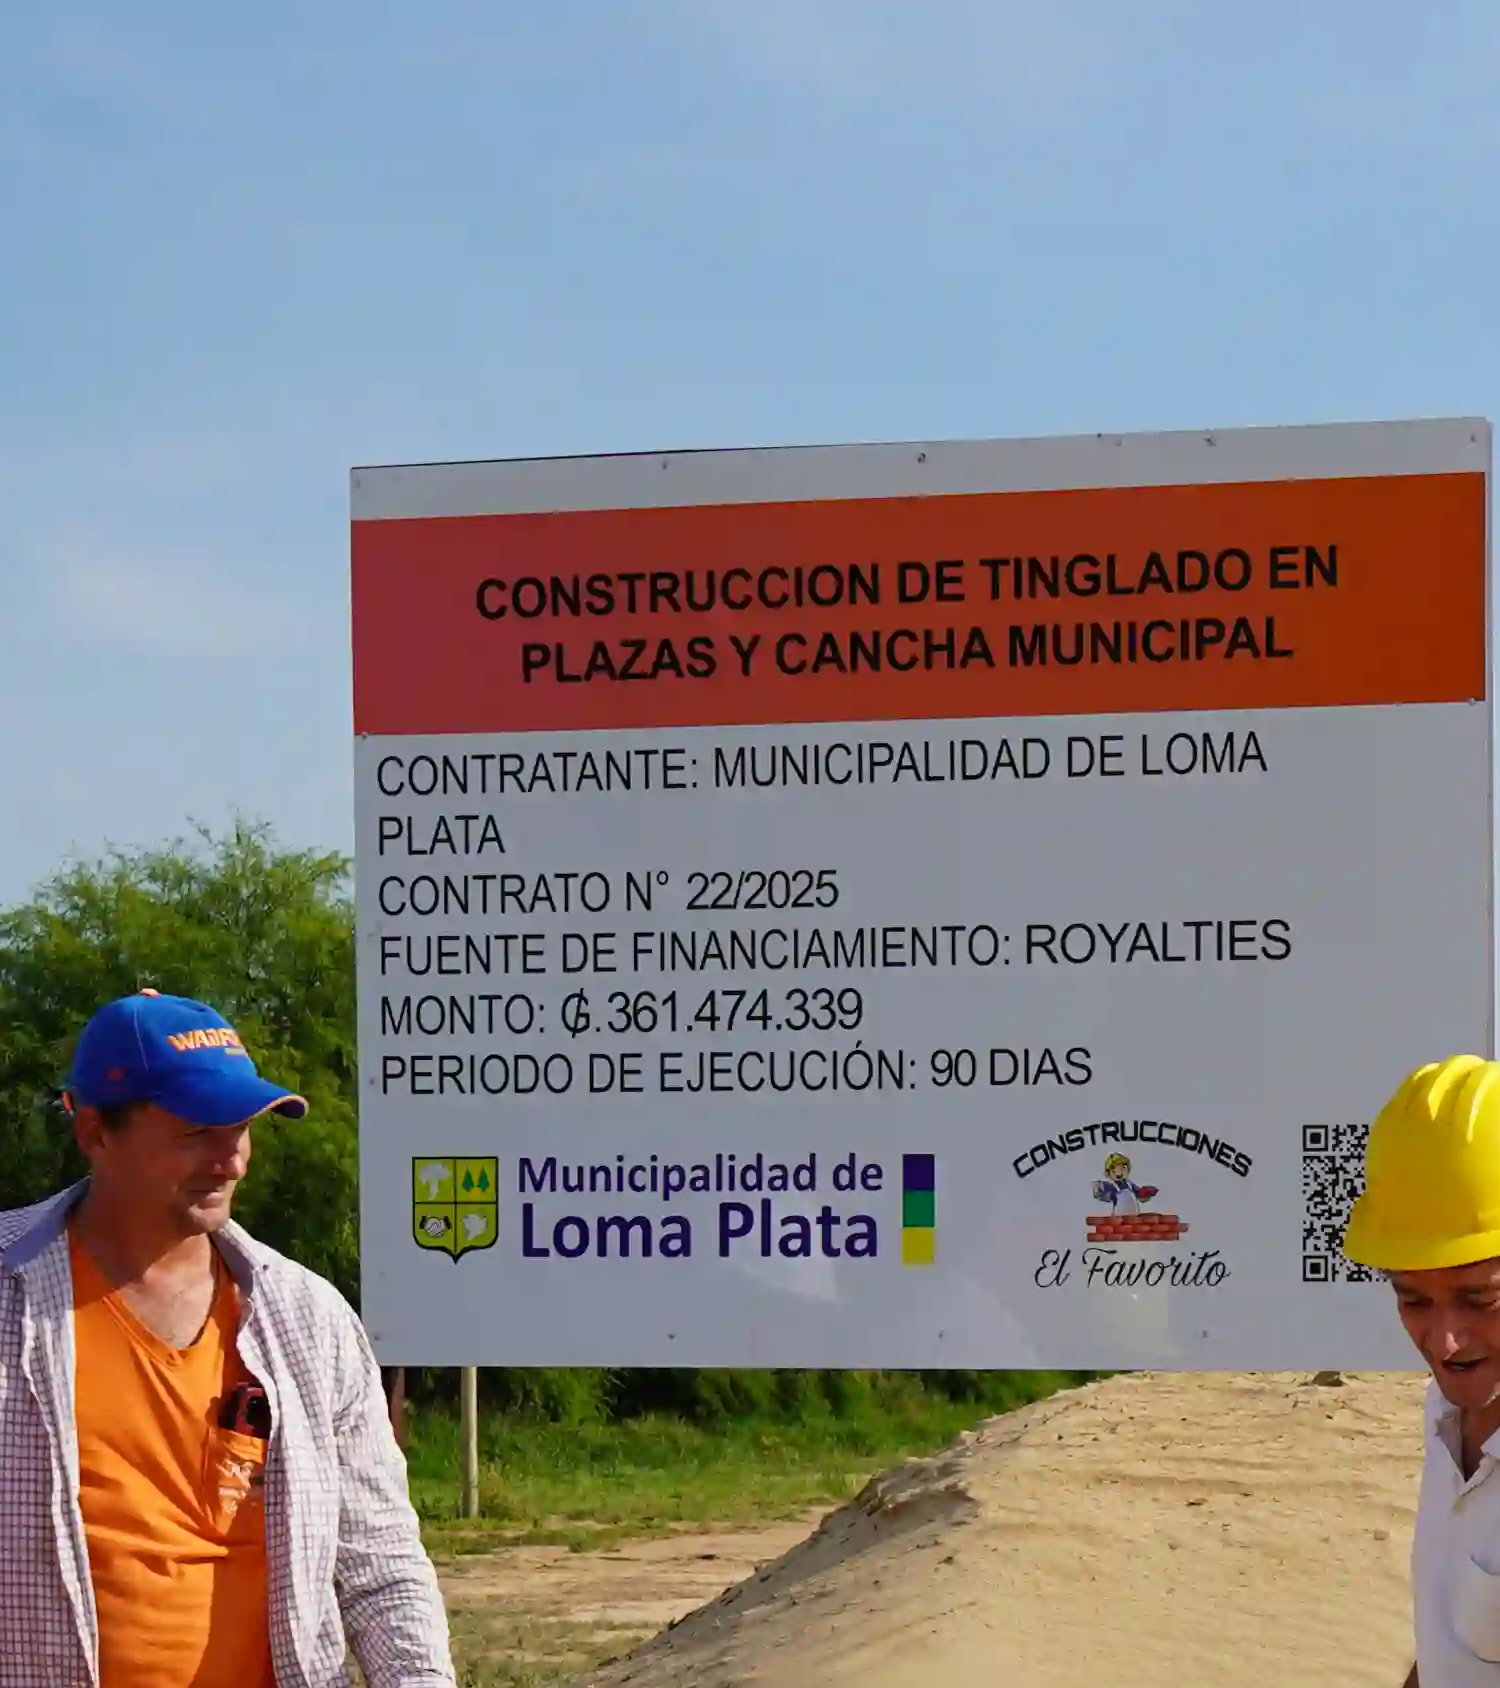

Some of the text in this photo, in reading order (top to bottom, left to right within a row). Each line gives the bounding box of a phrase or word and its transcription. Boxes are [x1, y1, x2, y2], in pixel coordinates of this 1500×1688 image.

[476, 544, 1338, 621] CONSTRUCCION DE TINGLADO EN
[522, 616, 1294, 684] PLAZAS Y CANCHA MUNICIPAL
[377, 730, 1268, 796] CONTRATANTE: MUNICIPALIDAD DE LOMA
[378, 814, 506, 856] PLATA
[378, 871, 610, 916] CONTRATO
[686, 869, 839, 910] 22/2025
[380, 919, 1292, 976] FUENTE DE FINANCIAMIENTO: ROYALTIES
[381, 994, 545, 1036] MONTO:
[382, 1039, 1092, 1095] PERIODO DE EJECUCIÓN: 90 DIAS
[518, 1152, 883, 1201] Municipalidad de
[1012, 1120, 1253, 1178] CONSTRUCCIONES
[522, 1197, 878, 1259] Loma Plata
[1034, 1247, 1231, 1288] El Favorito
